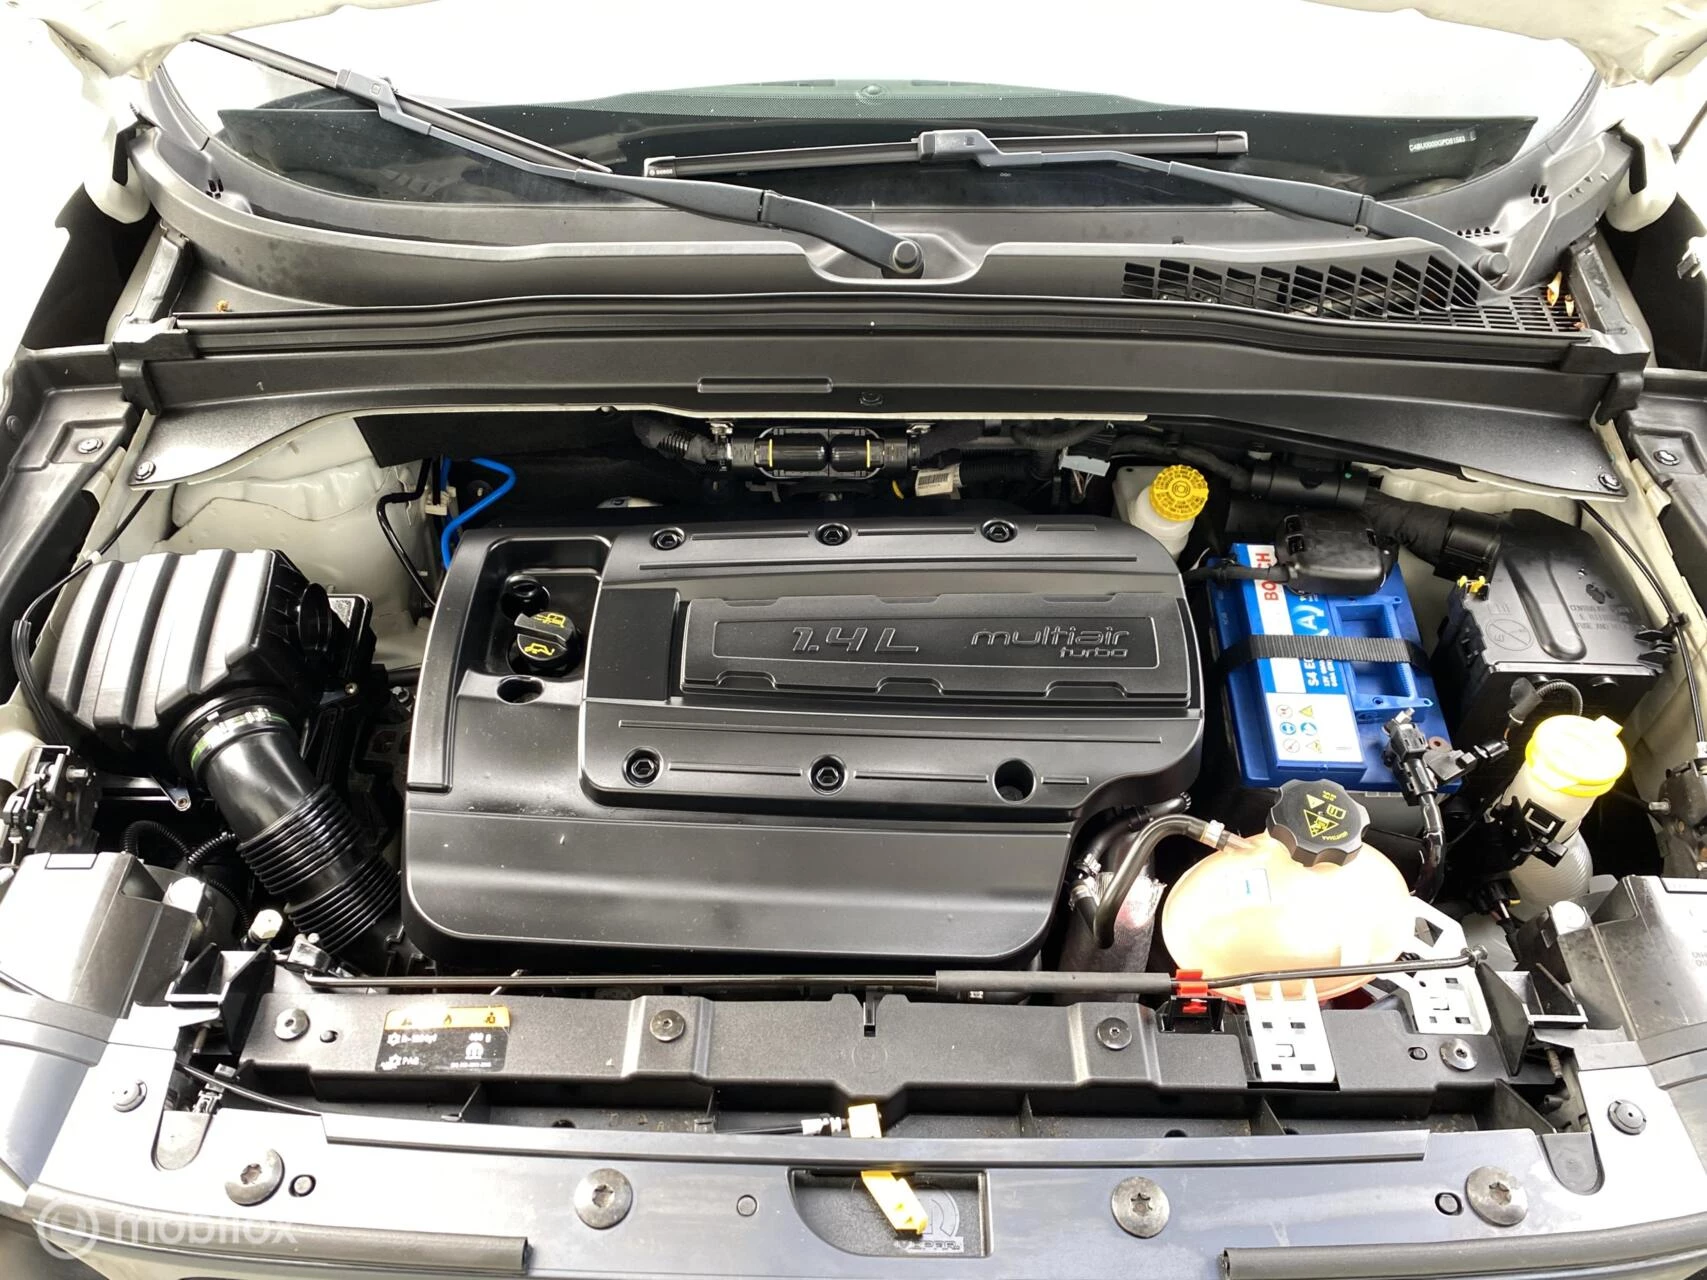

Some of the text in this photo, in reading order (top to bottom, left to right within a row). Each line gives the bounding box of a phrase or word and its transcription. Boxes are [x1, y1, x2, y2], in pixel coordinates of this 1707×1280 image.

[1256, 553, 1279, 601] BOH
[792, 627, 920, 652] 1.4 L
[971, 625, 1130, 646] multiair
[1059, 646, 1128, 658] turbo
